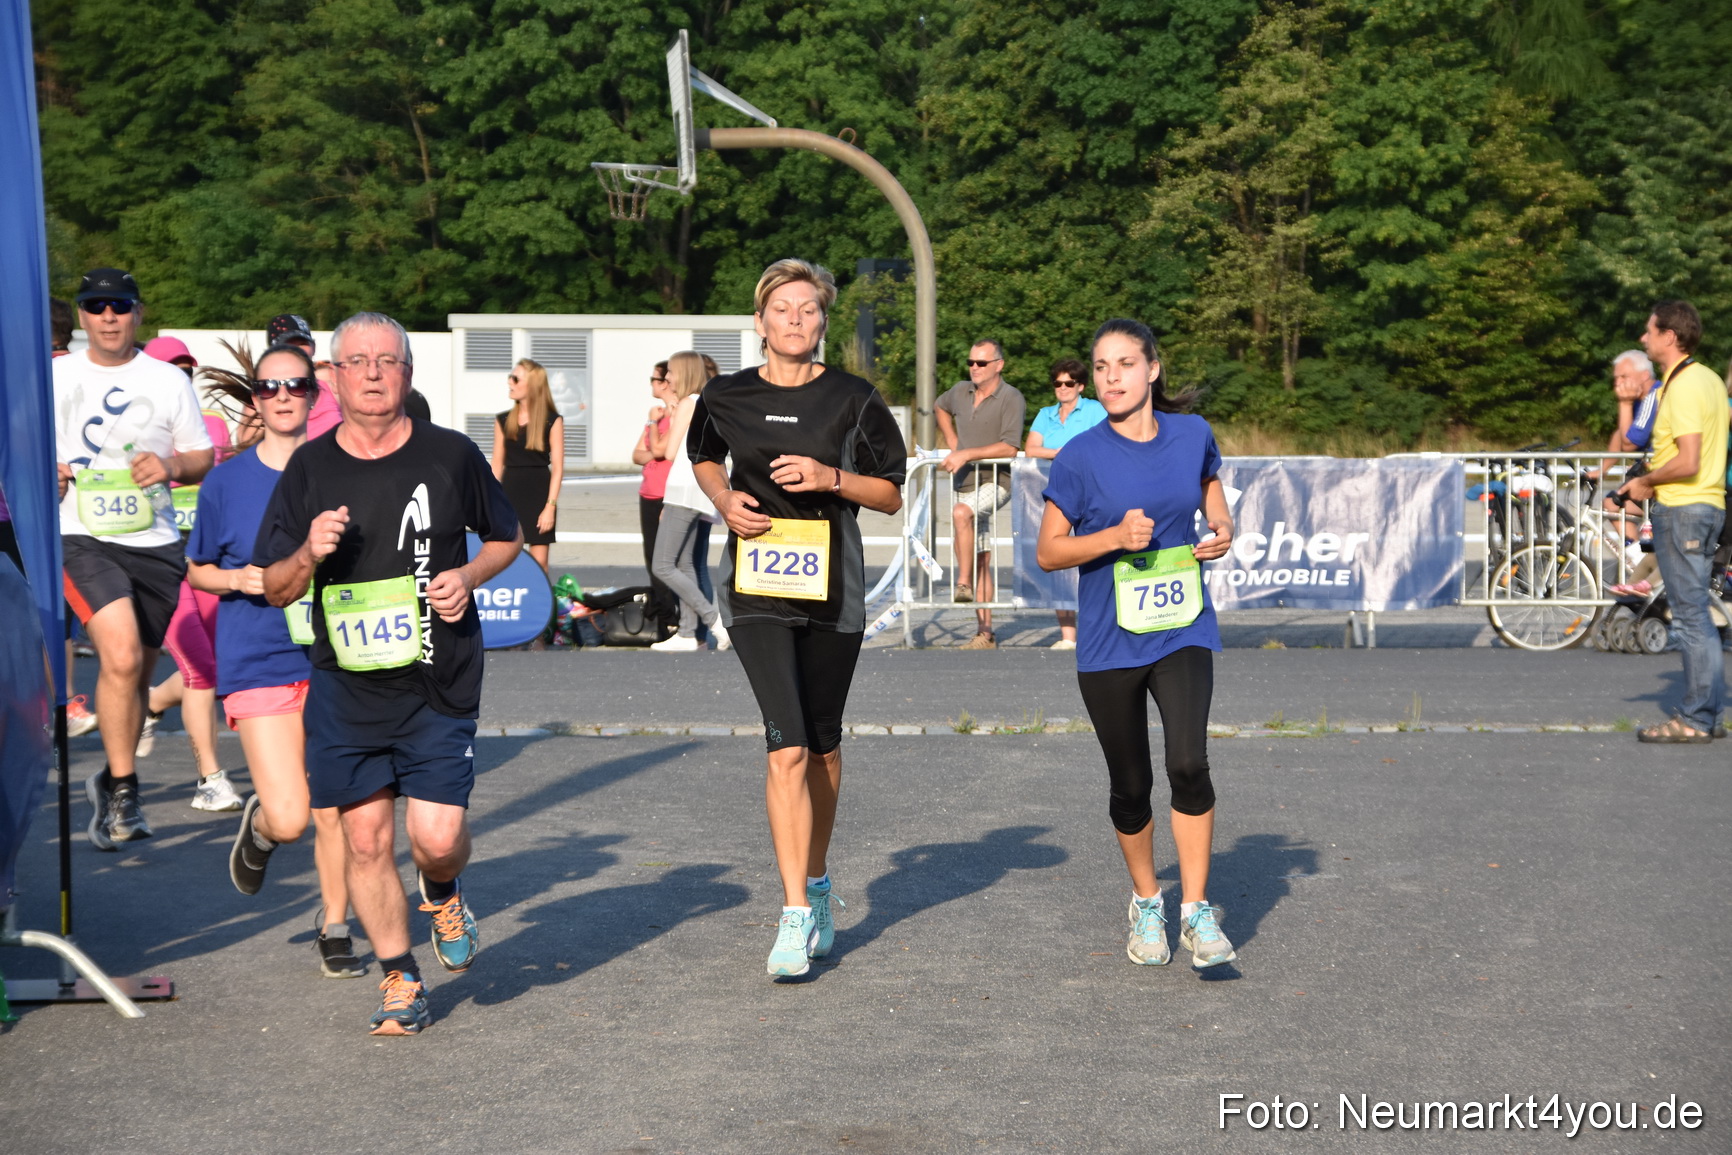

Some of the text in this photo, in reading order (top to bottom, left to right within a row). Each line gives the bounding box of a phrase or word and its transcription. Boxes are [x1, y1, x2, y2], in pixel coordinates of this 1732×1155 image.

[93, 495, 138, 516] 348
[747, 548, 819, 577] 1228
[1133, 580, 1185, 610] 758
[298, 601, 313, 623] 7
[336, 613, 413, 647] 1145
